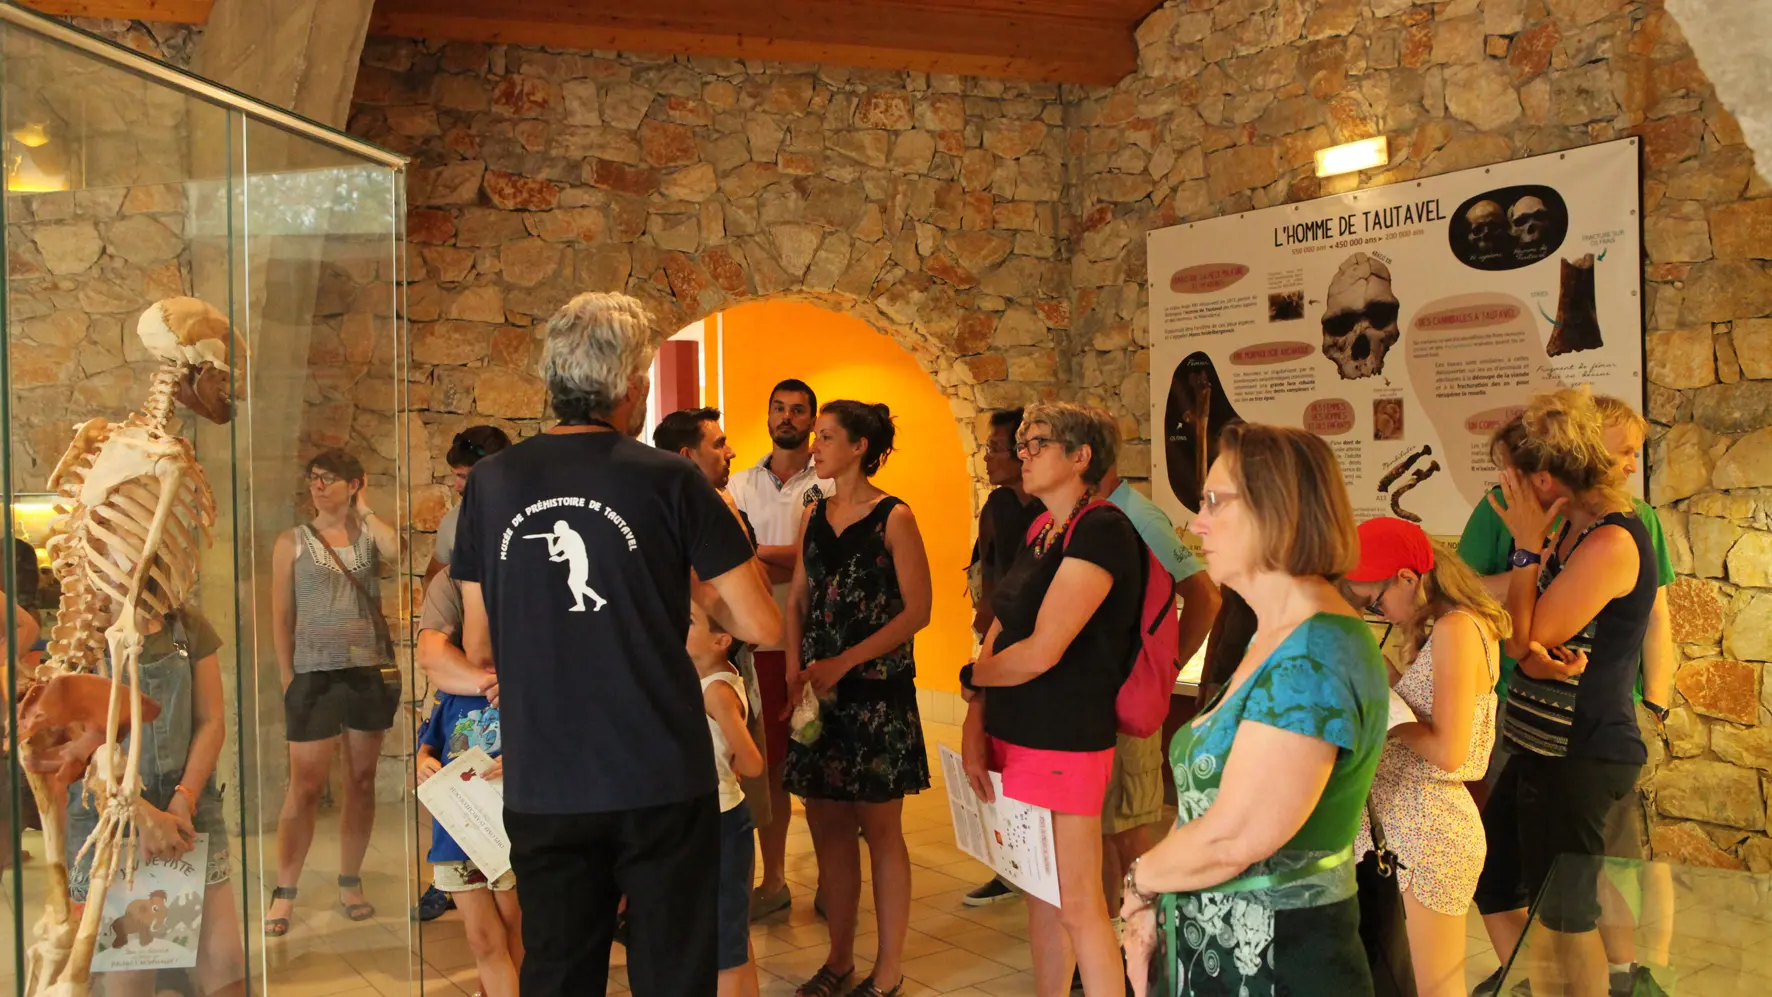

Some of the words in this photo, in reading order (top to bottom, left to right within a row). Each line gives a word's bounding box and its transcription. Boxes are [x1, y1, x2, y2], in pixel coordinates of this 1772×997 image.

[1275, 218, 1333, 247] L'HOMME
[1339, 214, 1356, 236] DE
[1362, 199, 1446, 232] TAUTAVEL
[500, 528, 513, 560] MUSÉE
[512, 513, 524, 527] DE
[525, 497, 585, 516] PRÉHISTOIRE
[589, 500, 601, 511] DE
[604, 507, 637, 551] TAUTAVEL
[164, 857, 195, 877] PISTE
